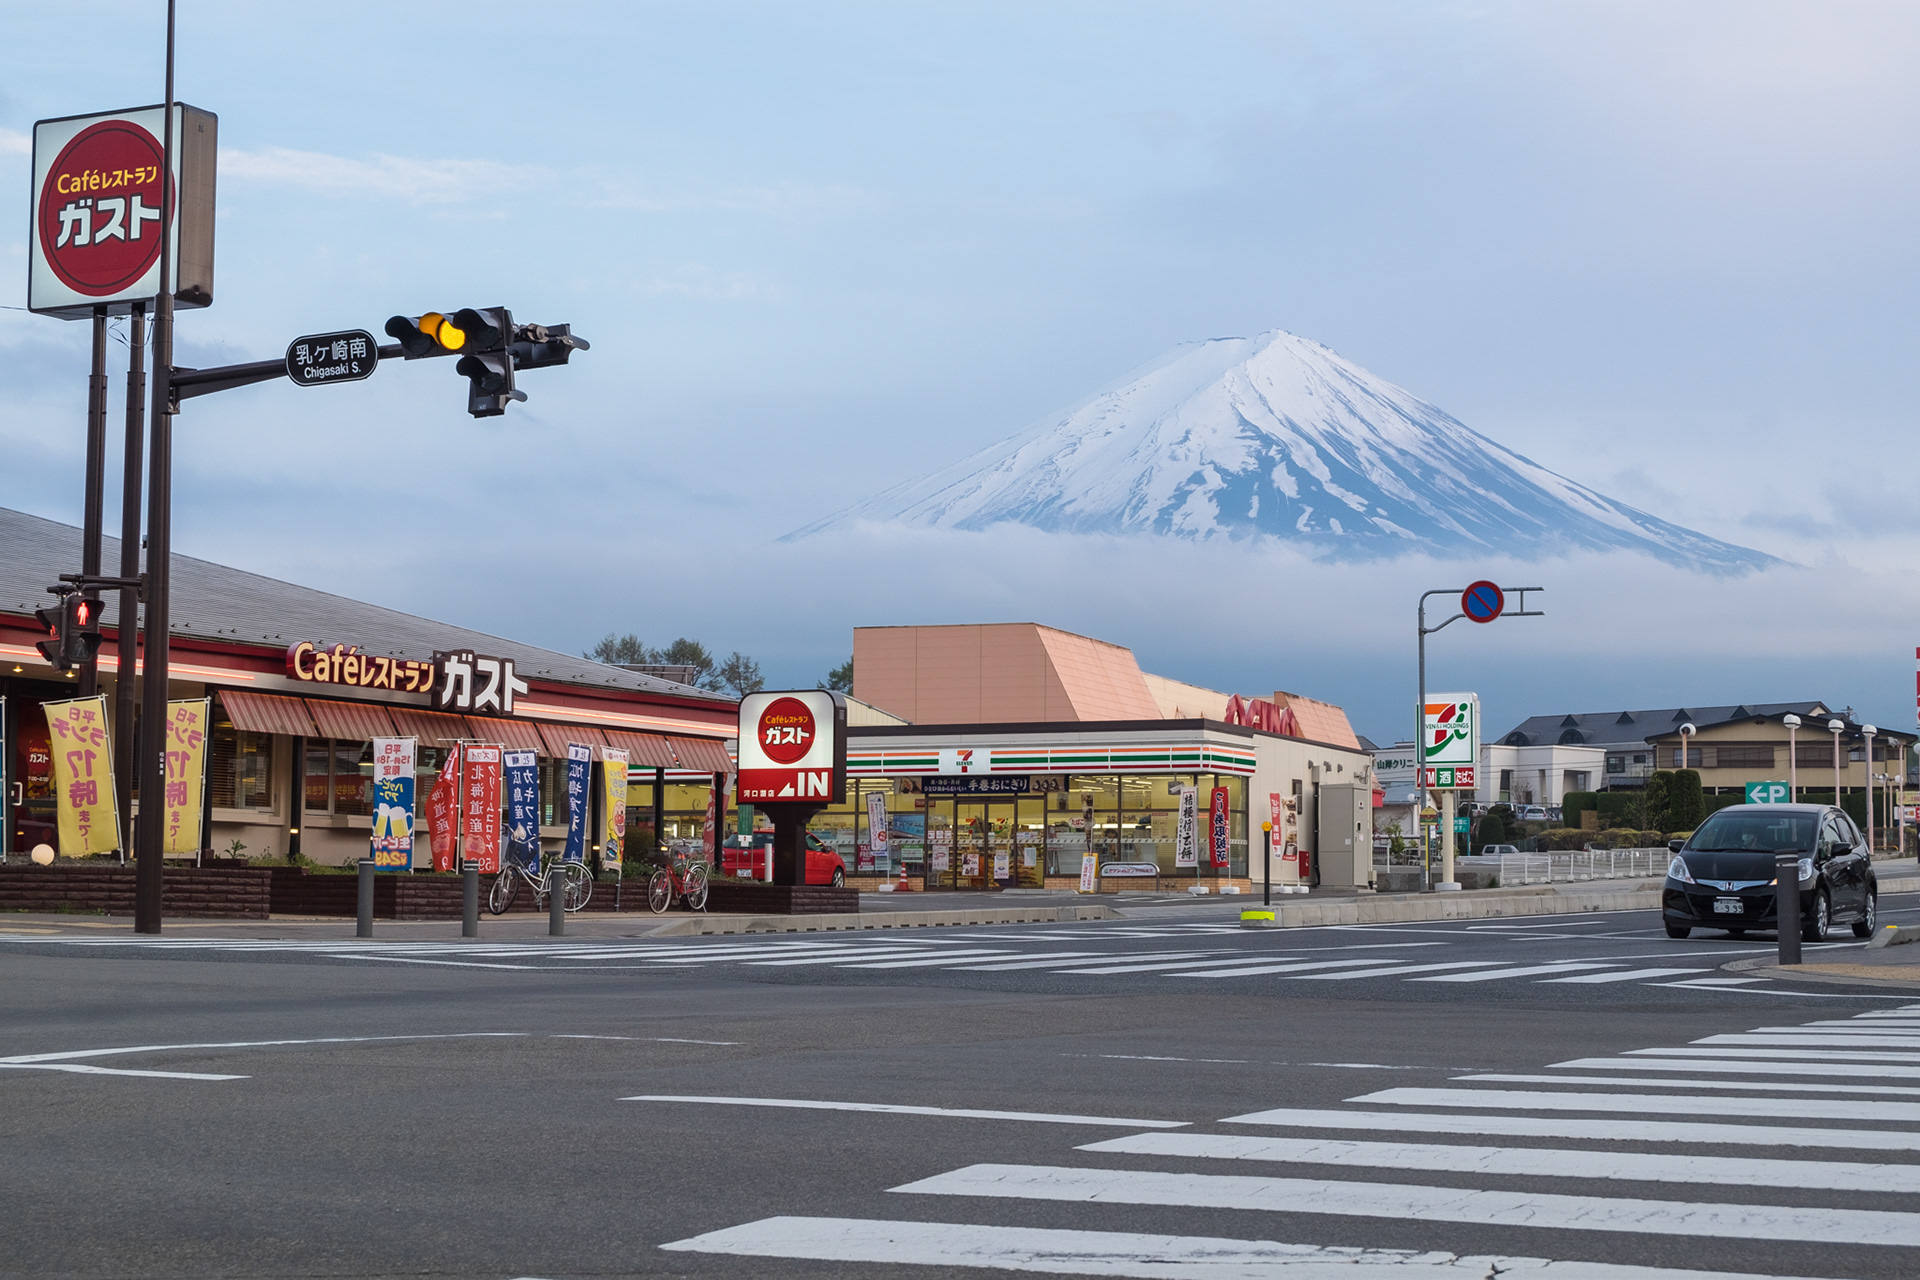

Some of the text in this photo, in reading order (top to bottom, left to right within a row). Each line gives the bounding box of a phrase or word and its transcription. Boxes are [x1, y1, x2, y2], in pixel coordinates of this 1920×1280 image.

[57, 195, 160, 249] ガスト
[304, 361, 362, 379] Chigasaki S.
[440, 652, 529, 713] ガスト
[765, 726, 810, 745] ガスト
[29, 753, 49, 764] ガスト
[797, 772, 829, 797] IN
[968, 778, 1028, 791] 手巻おにぎり
[1439, 771, 1452, 785] 酒
[1455, 770, 1474, 784] たばこ
[1769, 785, 1785, 803] P
